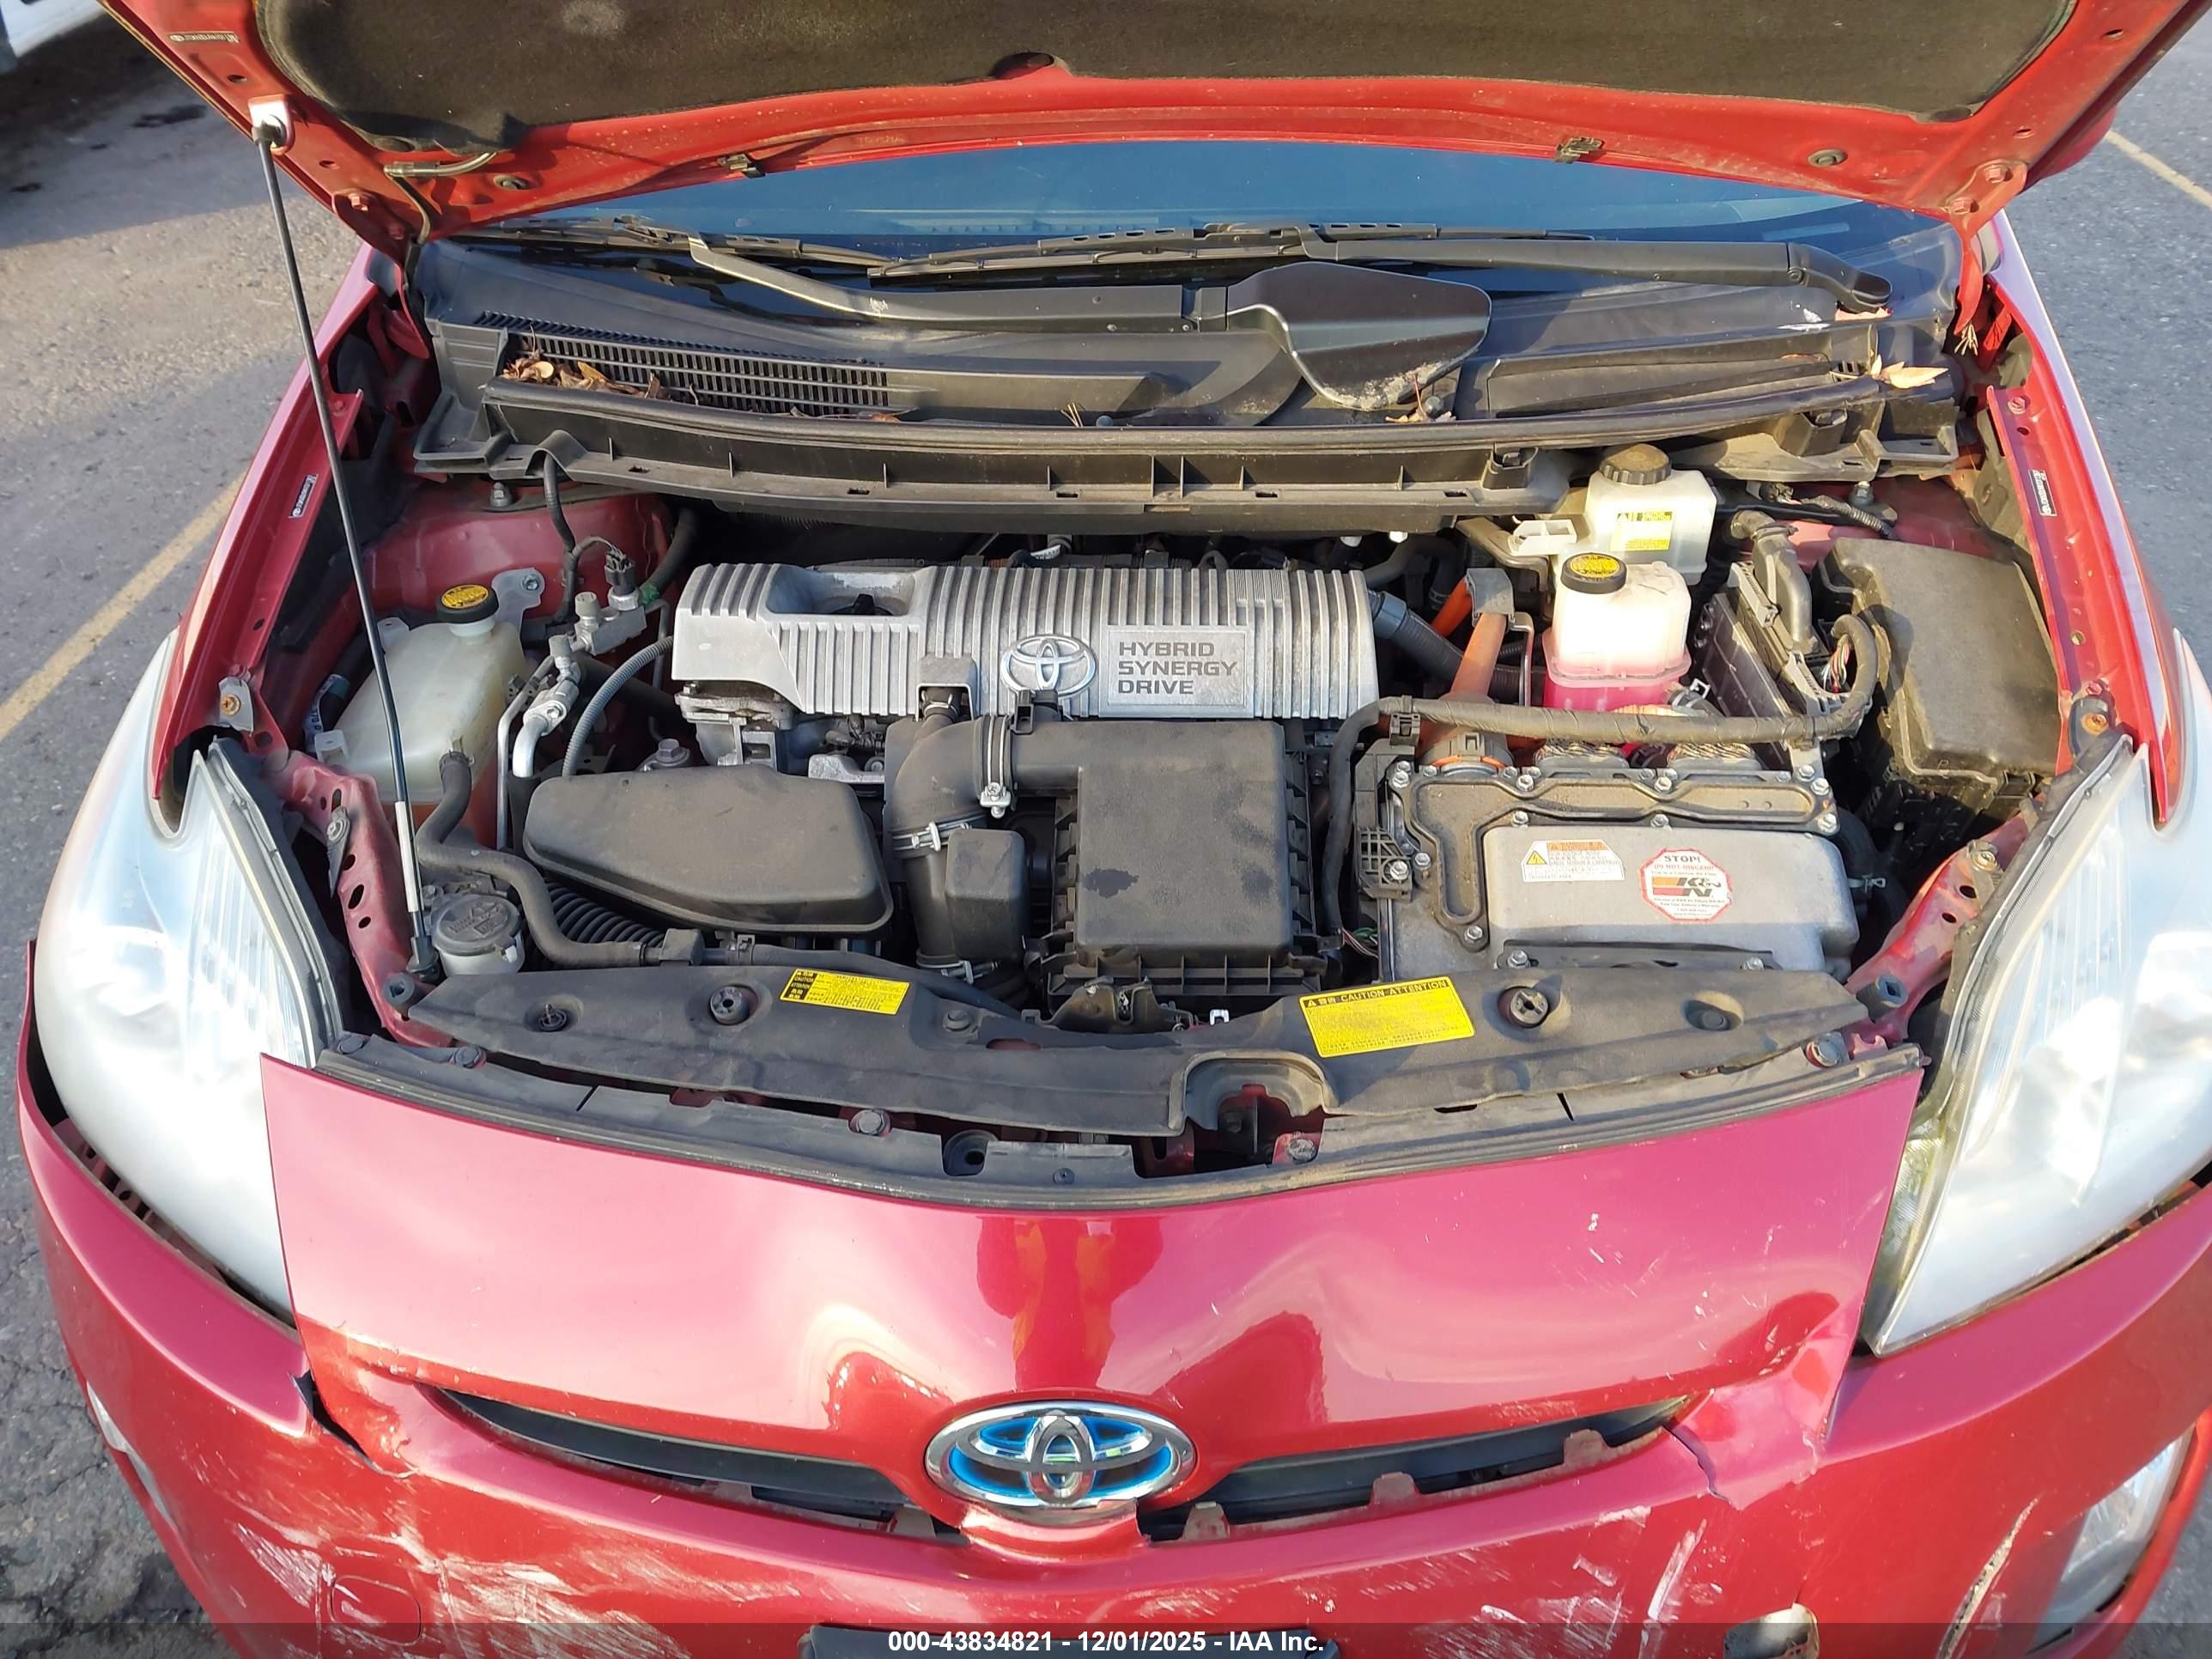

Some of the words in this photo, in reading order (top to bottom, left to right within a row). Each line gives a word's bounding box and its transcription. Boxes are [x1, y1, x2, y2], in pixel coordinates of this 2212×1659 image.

[1119, 641, 1215, 657] HYBRID
[1118, 660, 1237, 676] SYNERGY
[1118, 680, 1194, 695] DRIVE
[1340, 989, 1385, 1002] CAUTION
[1389, 980, 1446, 996] ATTENTION
